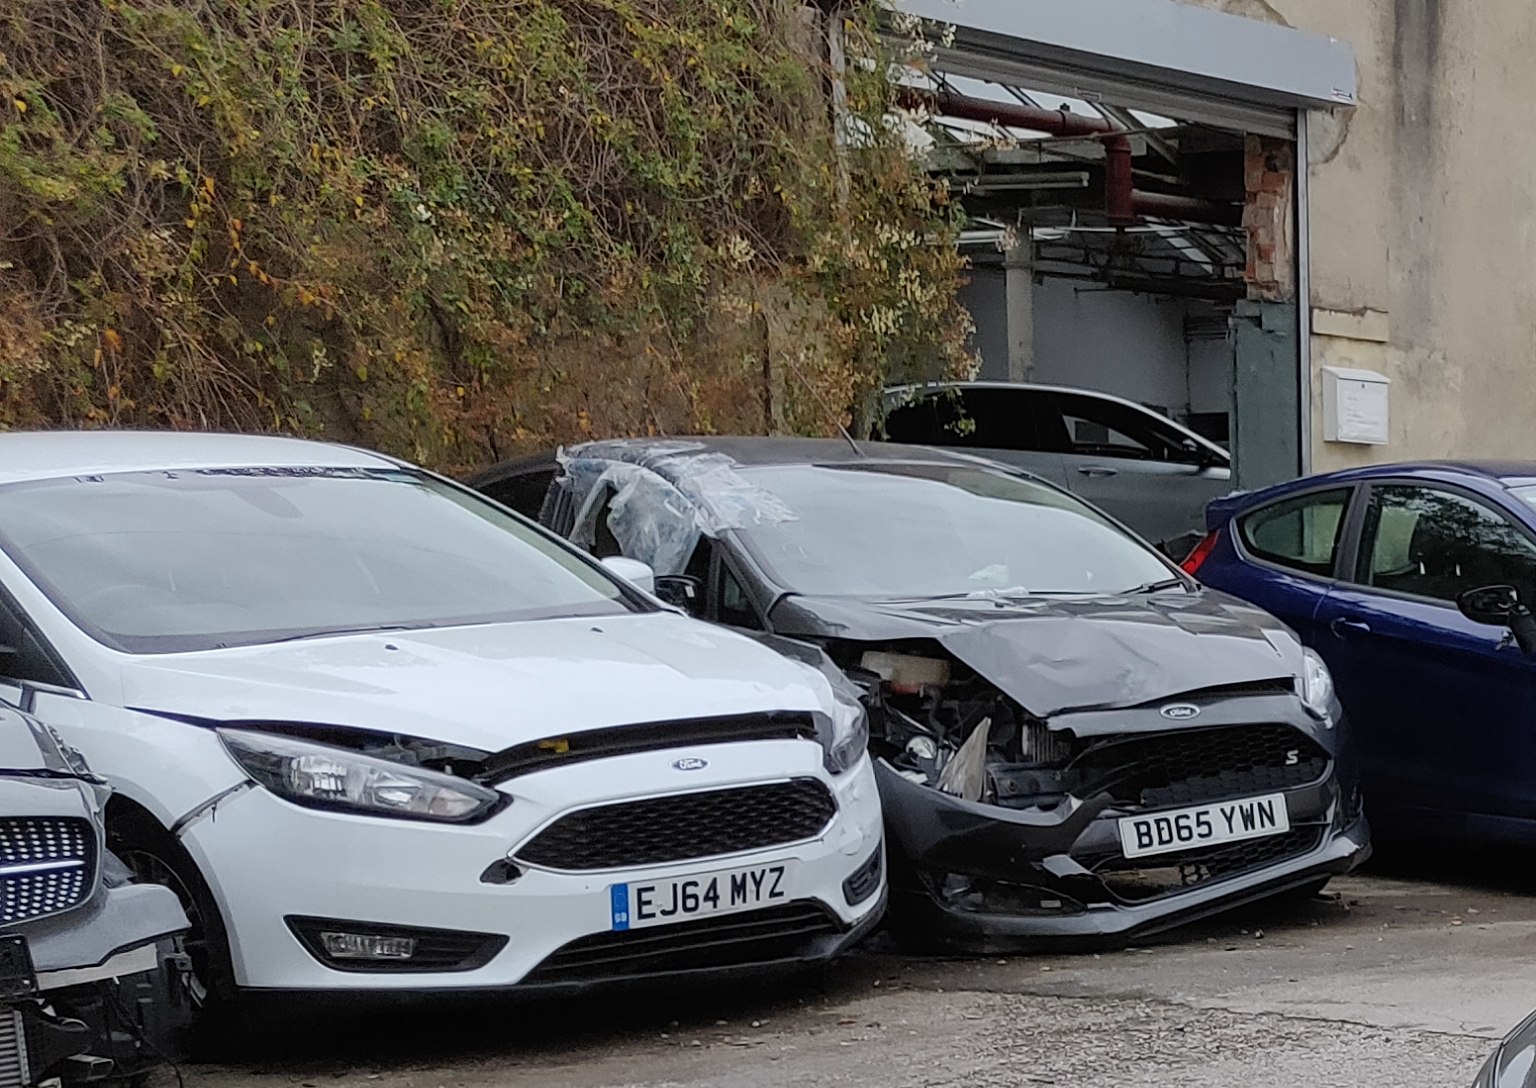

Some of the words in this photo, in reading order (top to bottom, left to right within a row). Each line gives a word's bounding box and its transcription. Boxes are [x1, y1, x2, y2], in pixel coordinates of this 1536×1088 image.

[1285, 750, 1299, 765] S
[1132, 810, 1214, 850] BD65
[1219, 799, 1277, 835] YWN
[636, 876, 720, 921] EJ64
[730, 865, 785, 907] MYZ
